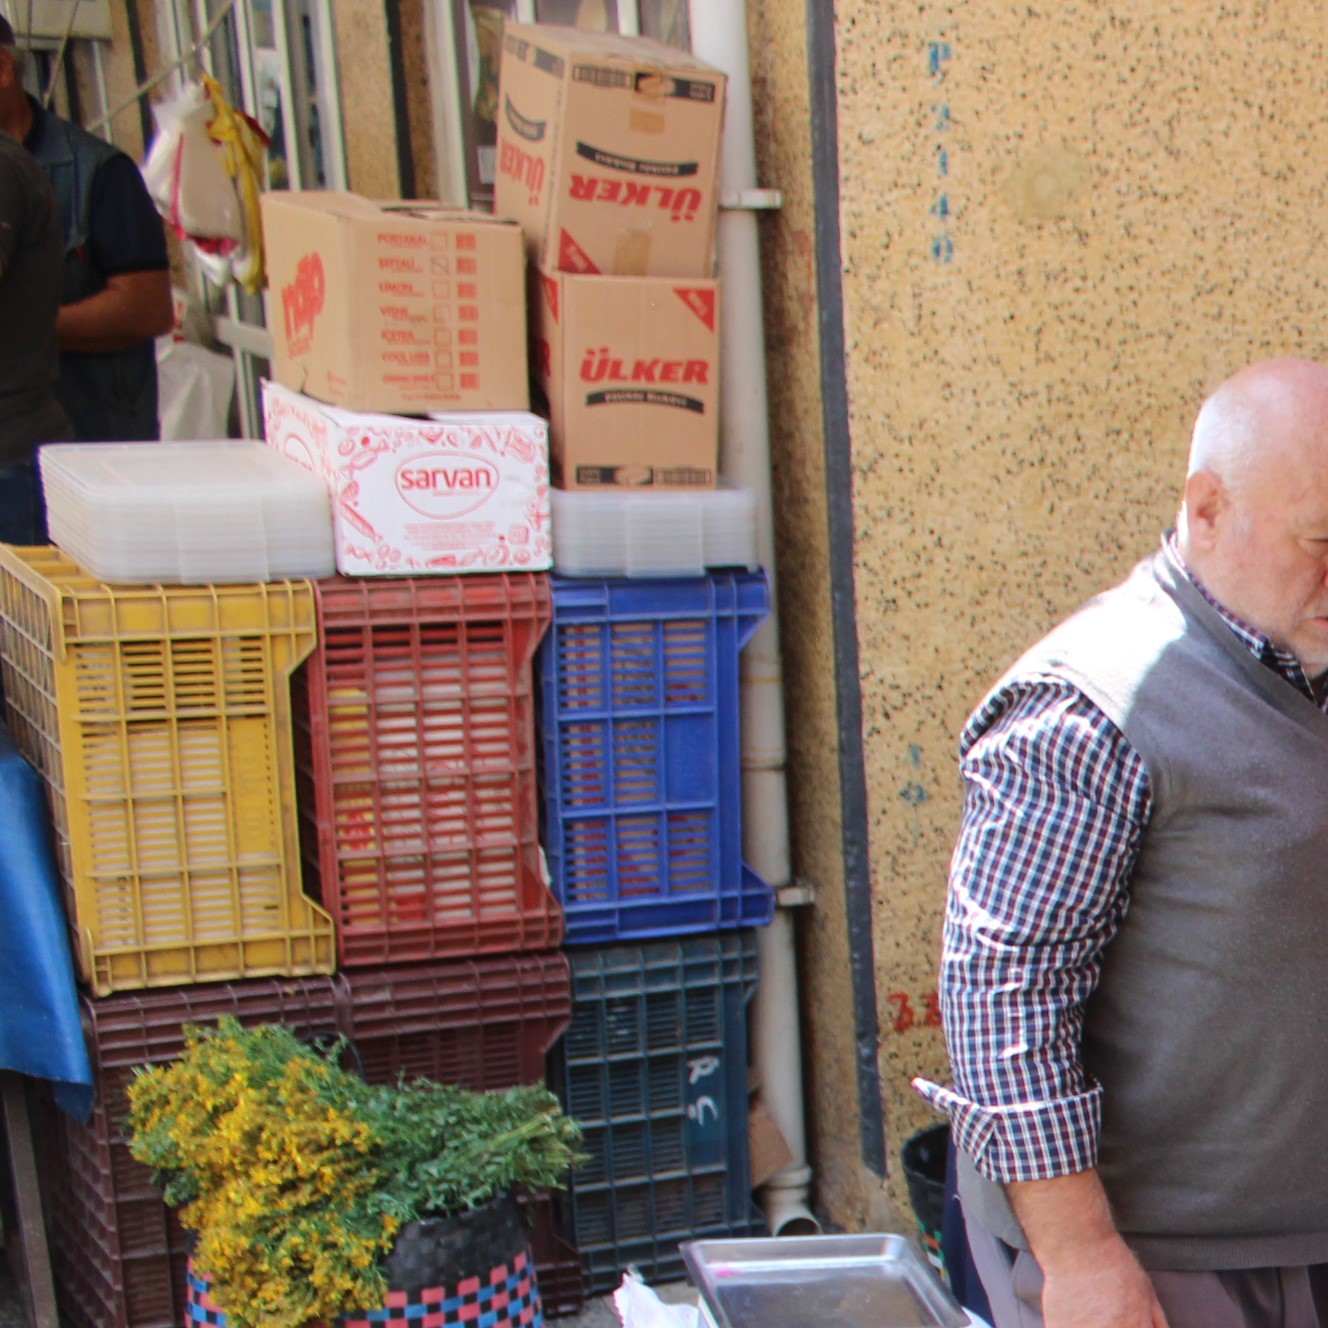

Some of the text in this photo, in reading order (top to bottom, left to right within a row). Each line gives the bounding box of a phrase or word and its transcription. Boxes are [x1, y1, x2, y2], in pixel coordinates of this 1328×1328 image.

[569, 173, 702, 222] ÜLKER
[580, 347, 709, 384] ÜLKER
[400, 467, 492, 491] sarvan
